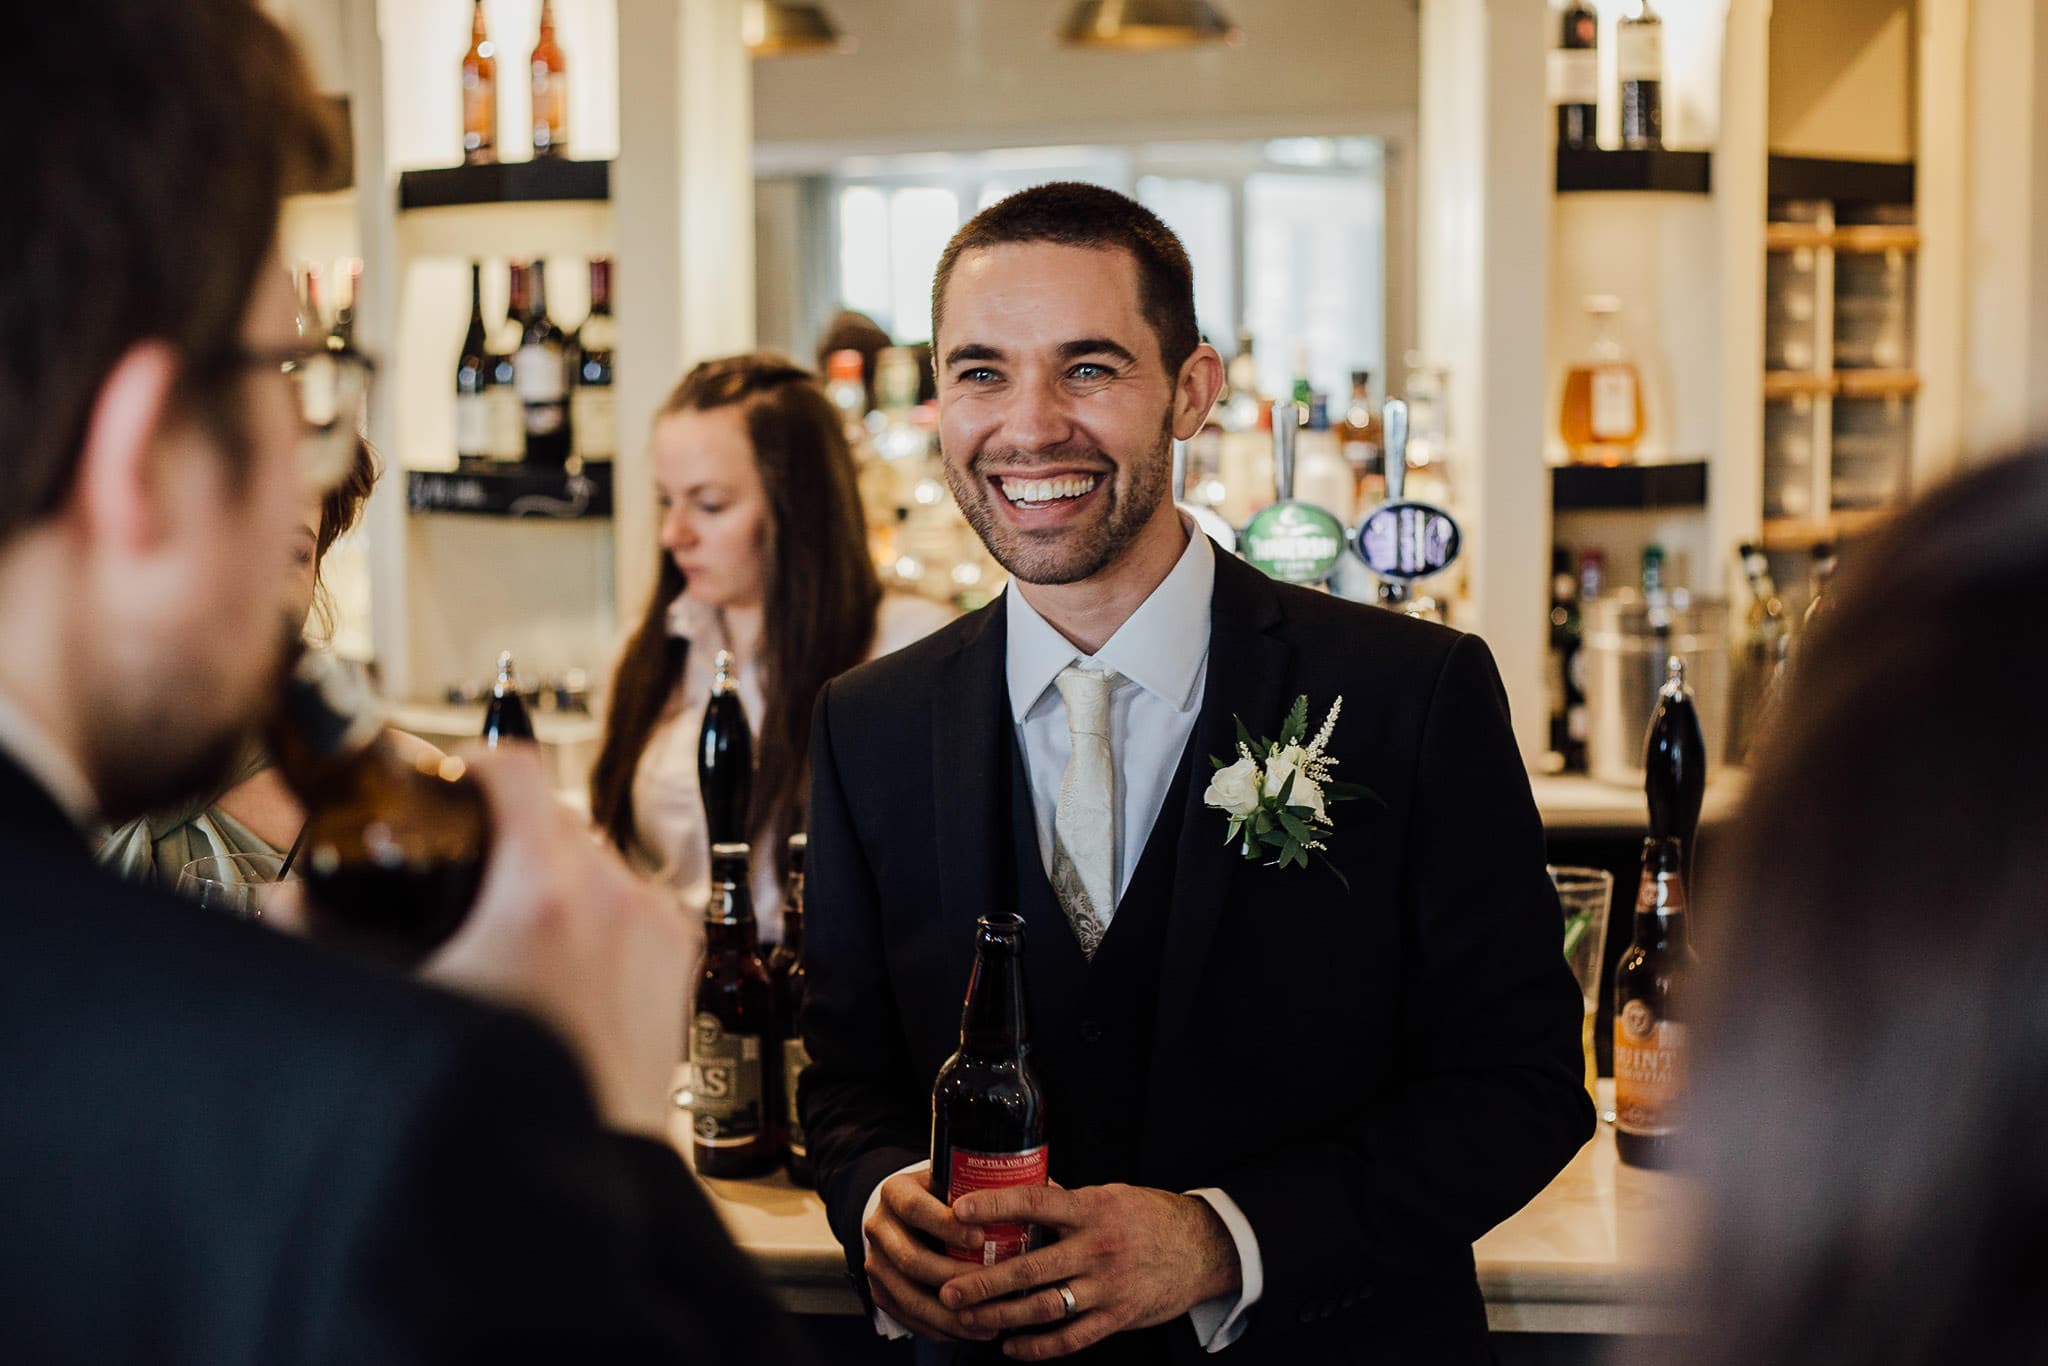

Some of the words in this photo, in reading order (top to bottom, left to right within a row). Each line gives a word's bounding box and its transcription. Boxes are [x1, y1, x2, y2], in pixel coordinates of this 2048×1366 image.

[690, 1063, 728, 1098] AS
[967, 1157, 985, 1168] HOP
[987, 1159, 1005, 1169] TILL
[1006, 1157, 1022, 1168] YOU
